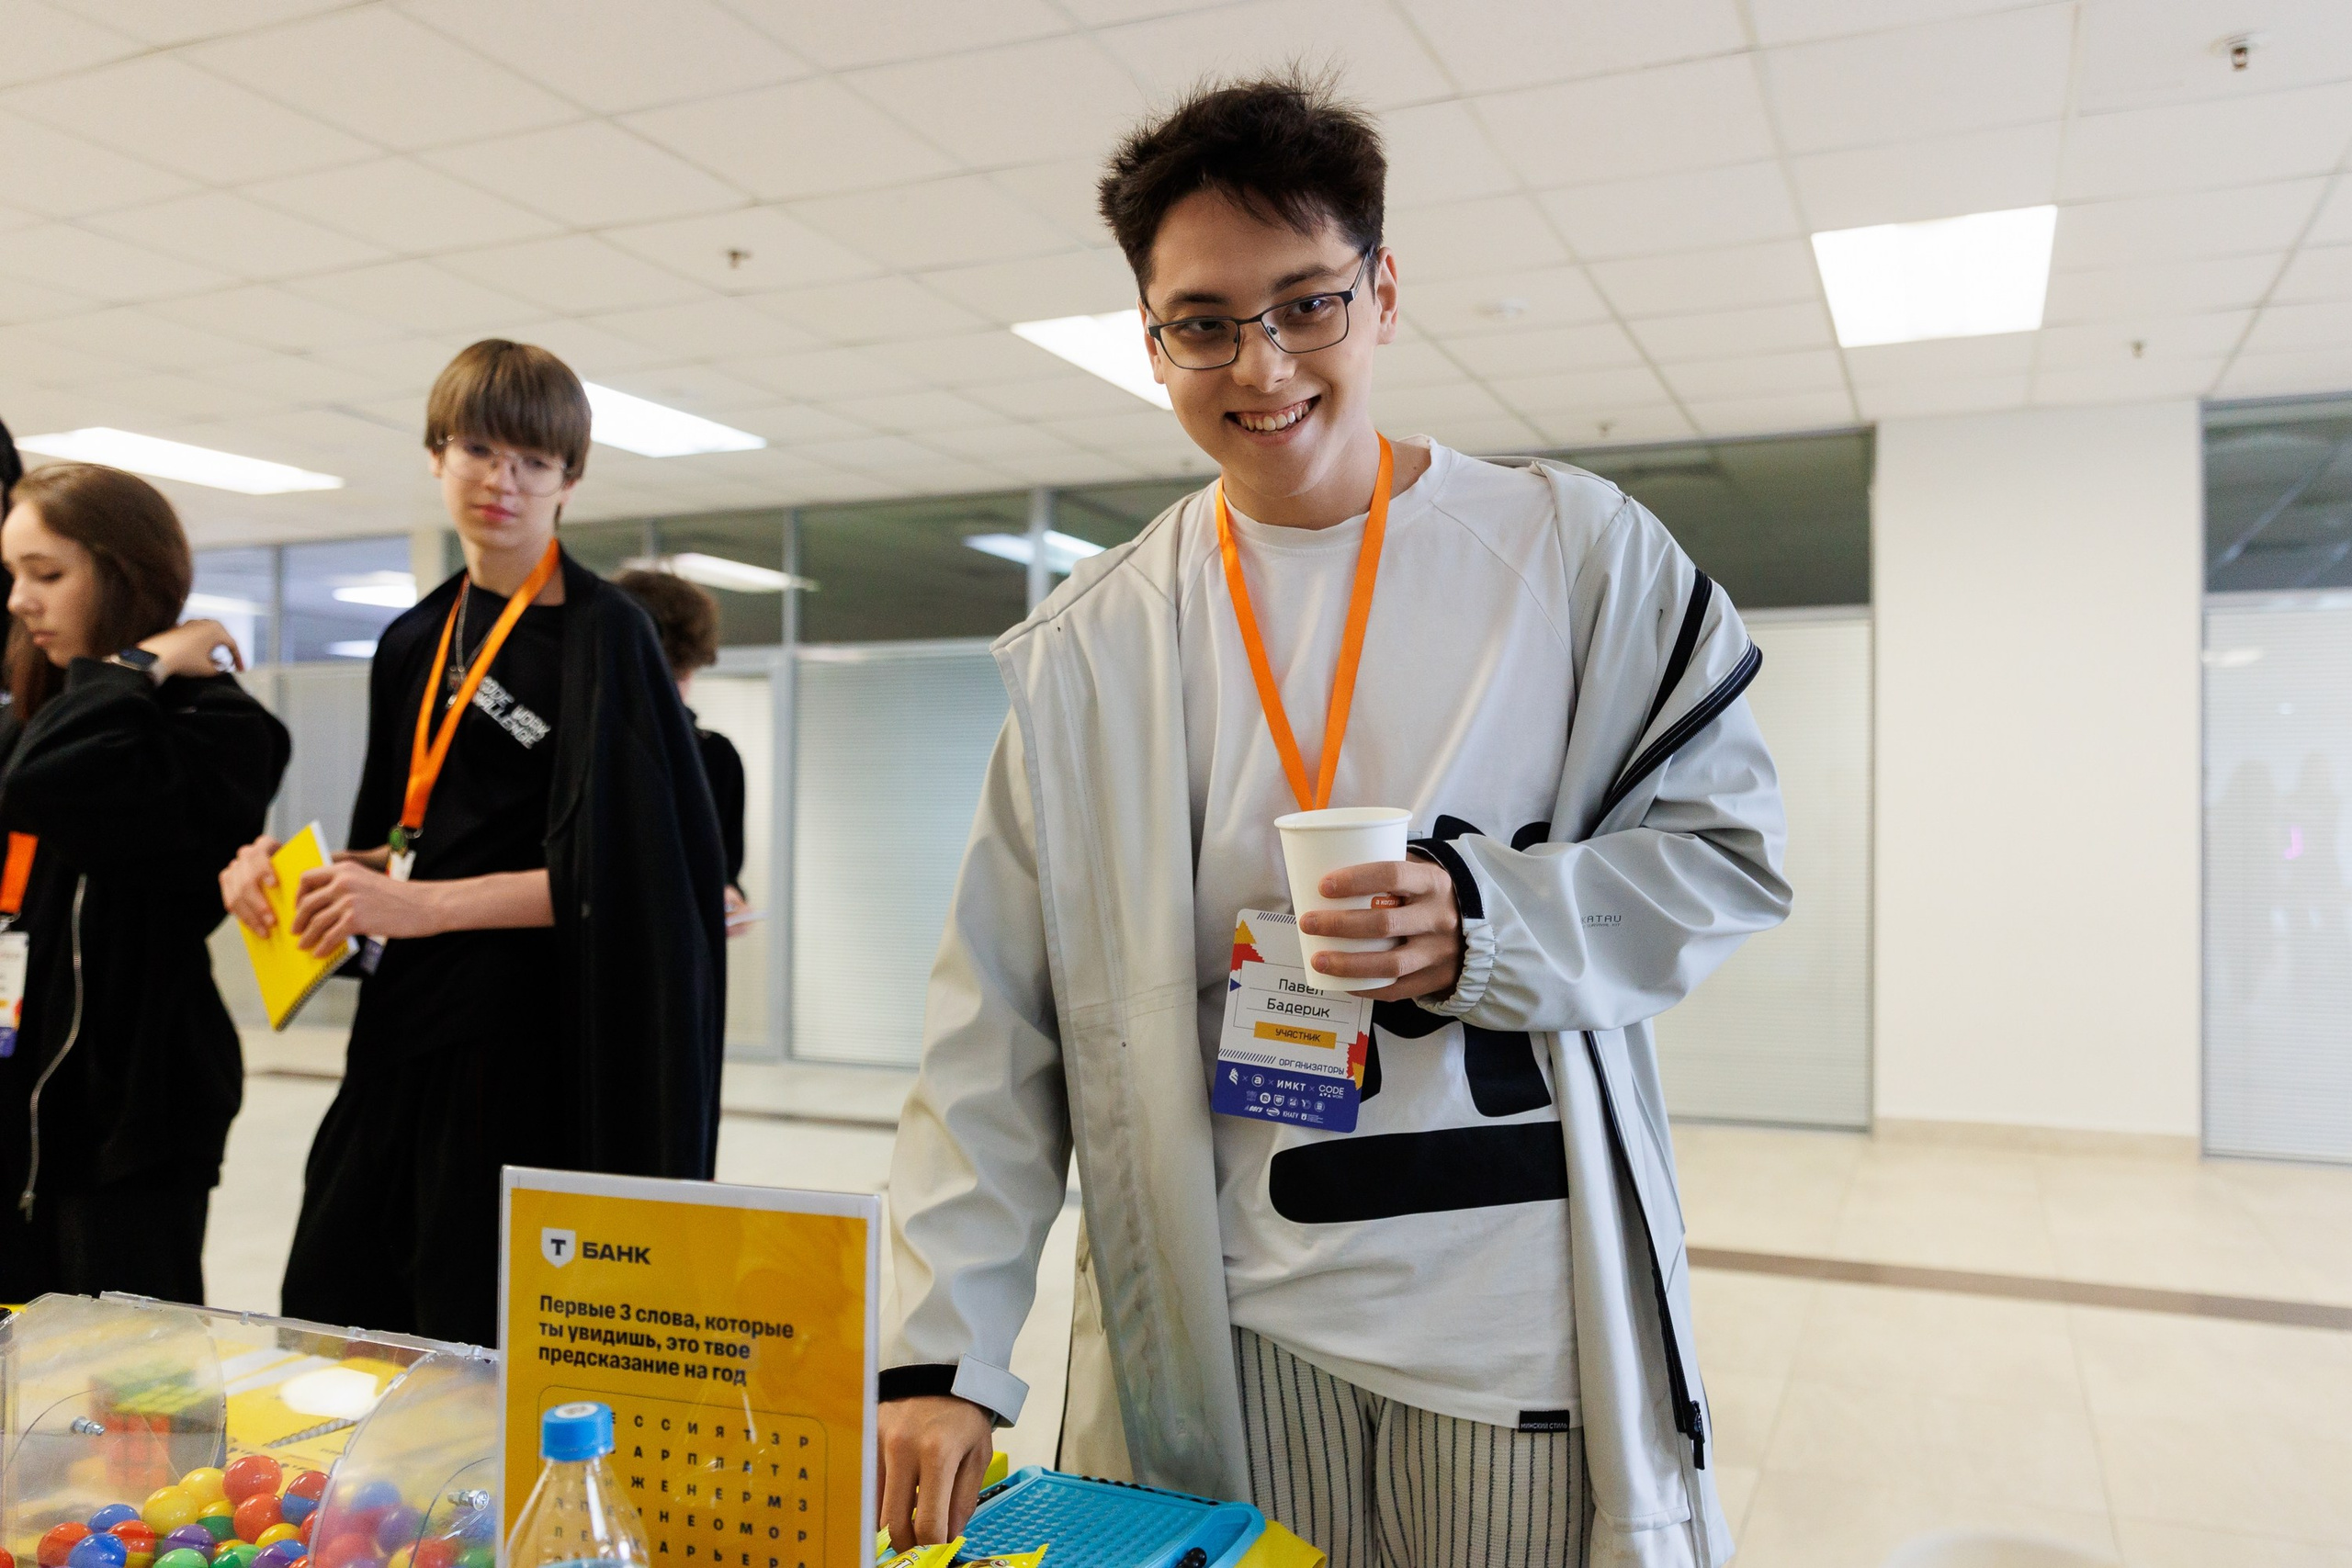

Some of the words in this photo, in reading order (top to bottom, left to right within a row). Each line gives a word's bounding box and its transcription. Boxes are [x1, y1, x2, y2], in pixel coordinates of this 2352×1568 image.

[1267, 998, 1330, 1018] Бадерик
[1275, 1028, 1321, 1042] УЧАСТНИК
[1279, 1057, 1345, 1075] ОРГАНИЗАТОРЫ
[1276, 1079, 1306, 1092] ИМКТ
[1318, 1084, 1345, 1096] CODE
[582, 1241, 651, 1266] БАНК
[540, 1294, 616, 1320] Первые
[619, 1303, 632, 1322] 3
[635, 1308, 701, 1332] слова,
[705, 1315, 794, 1339] которые
[538, 1322, 564, 1337] ты
[568, 1325, 662, 1352] увидишь,
[666, 1337, 700, 1354] это
[704, 1340, 751, 1359] твое
[538, 1346, 681, 1377] предсказание
[684, 1363, 708, 1380] на
[712, 1366, 747, 1387] год
